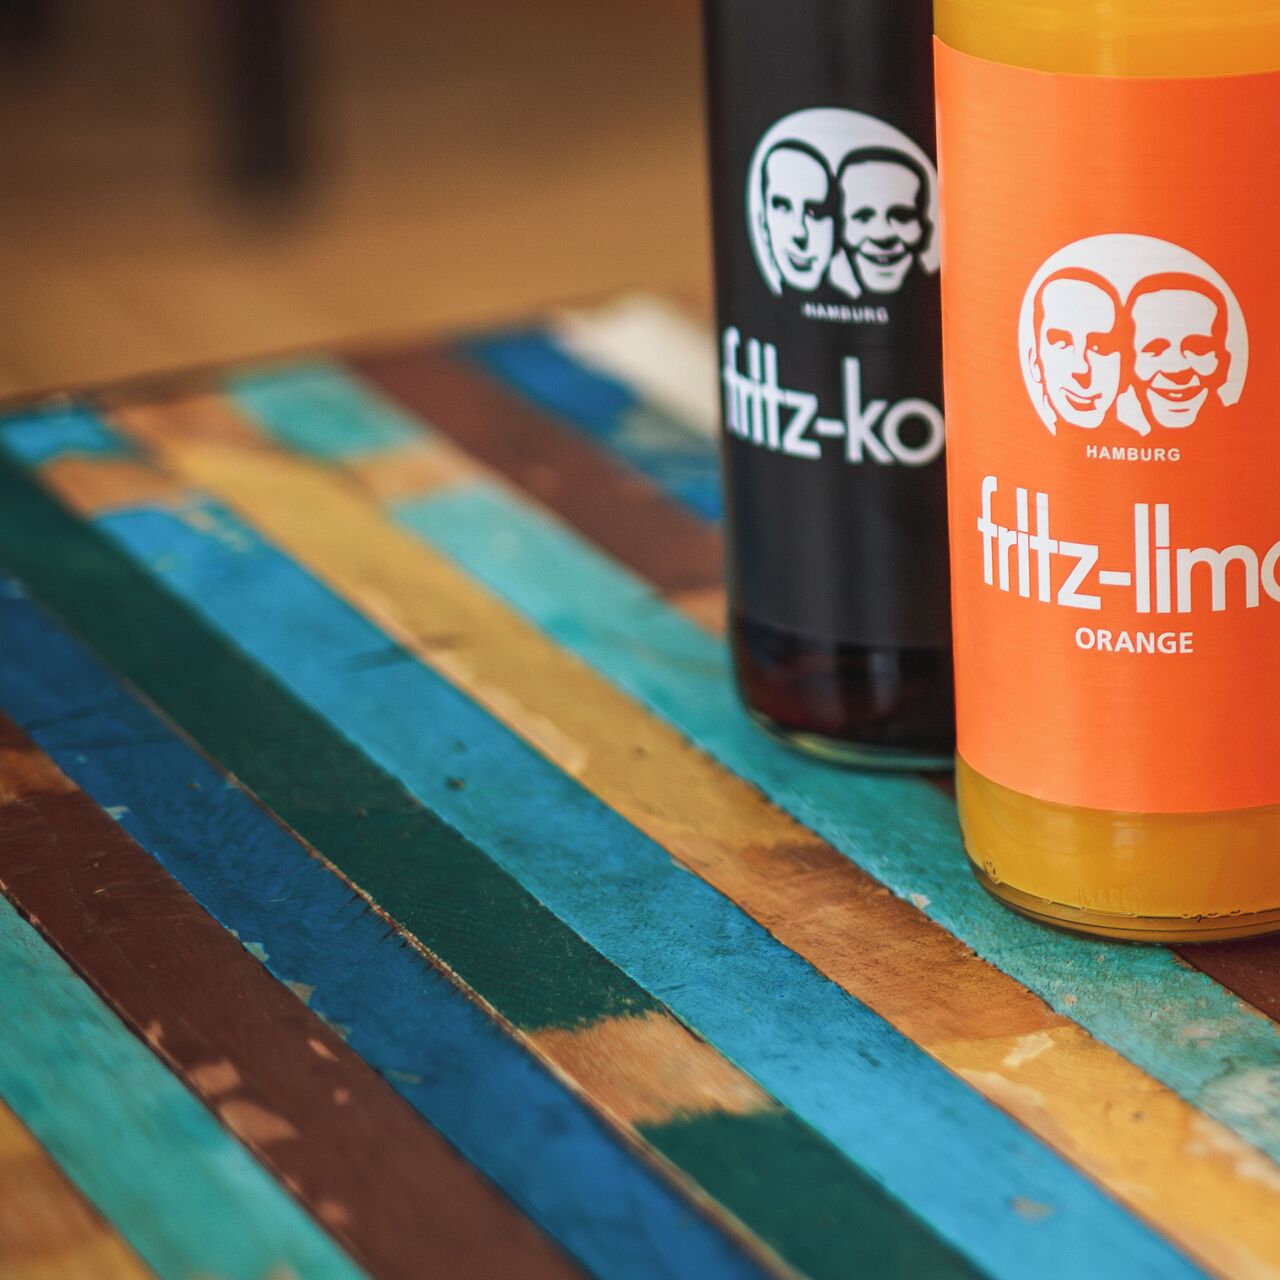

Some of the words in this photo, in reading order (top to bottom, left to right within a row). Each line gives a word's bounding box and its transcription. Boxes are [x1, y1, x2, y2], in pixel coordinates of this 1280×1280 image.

[803, 302, 889, 324] HAMBURG
[722, 326, 946, 465] fritz-ko
[1086, 445, 1181, 461] HAMBURG
[1075, 627, 1194, 654] ORANGE
